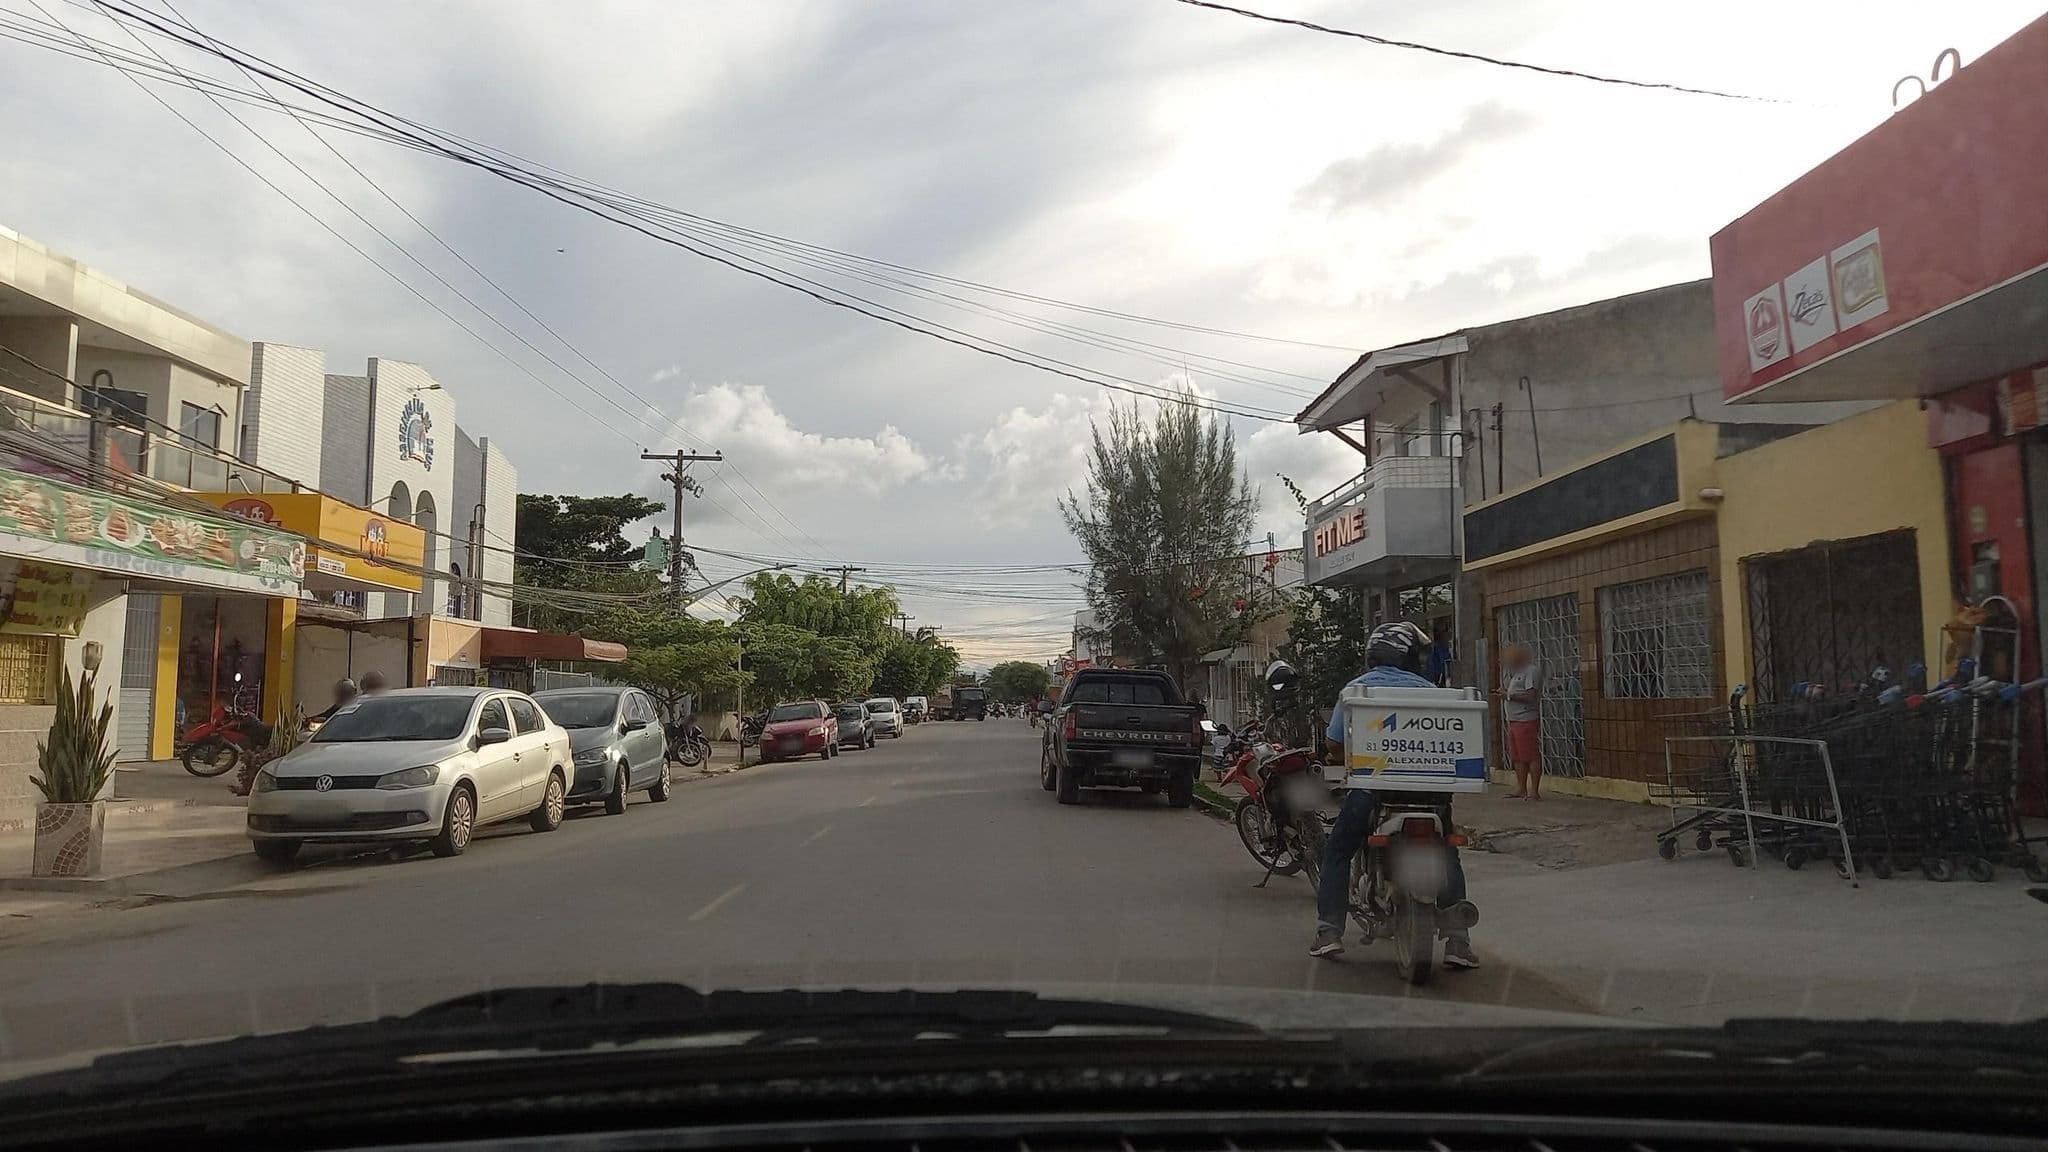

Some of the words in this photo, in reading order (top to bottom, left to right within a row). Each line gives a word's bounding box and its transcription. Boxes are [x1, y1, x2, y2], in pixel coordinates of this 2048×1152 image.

[1313, 519, 1336, 558] FIT
[1335, 507, 1367, 548] ME
[1083, 730, 1184, 742] CHEVROLET
[1366, 742, 1377, 752] 81
[1381, 738, 1464, 754] 99844.1143
[1387, 756, 1455, 765] ALEXANDRE
